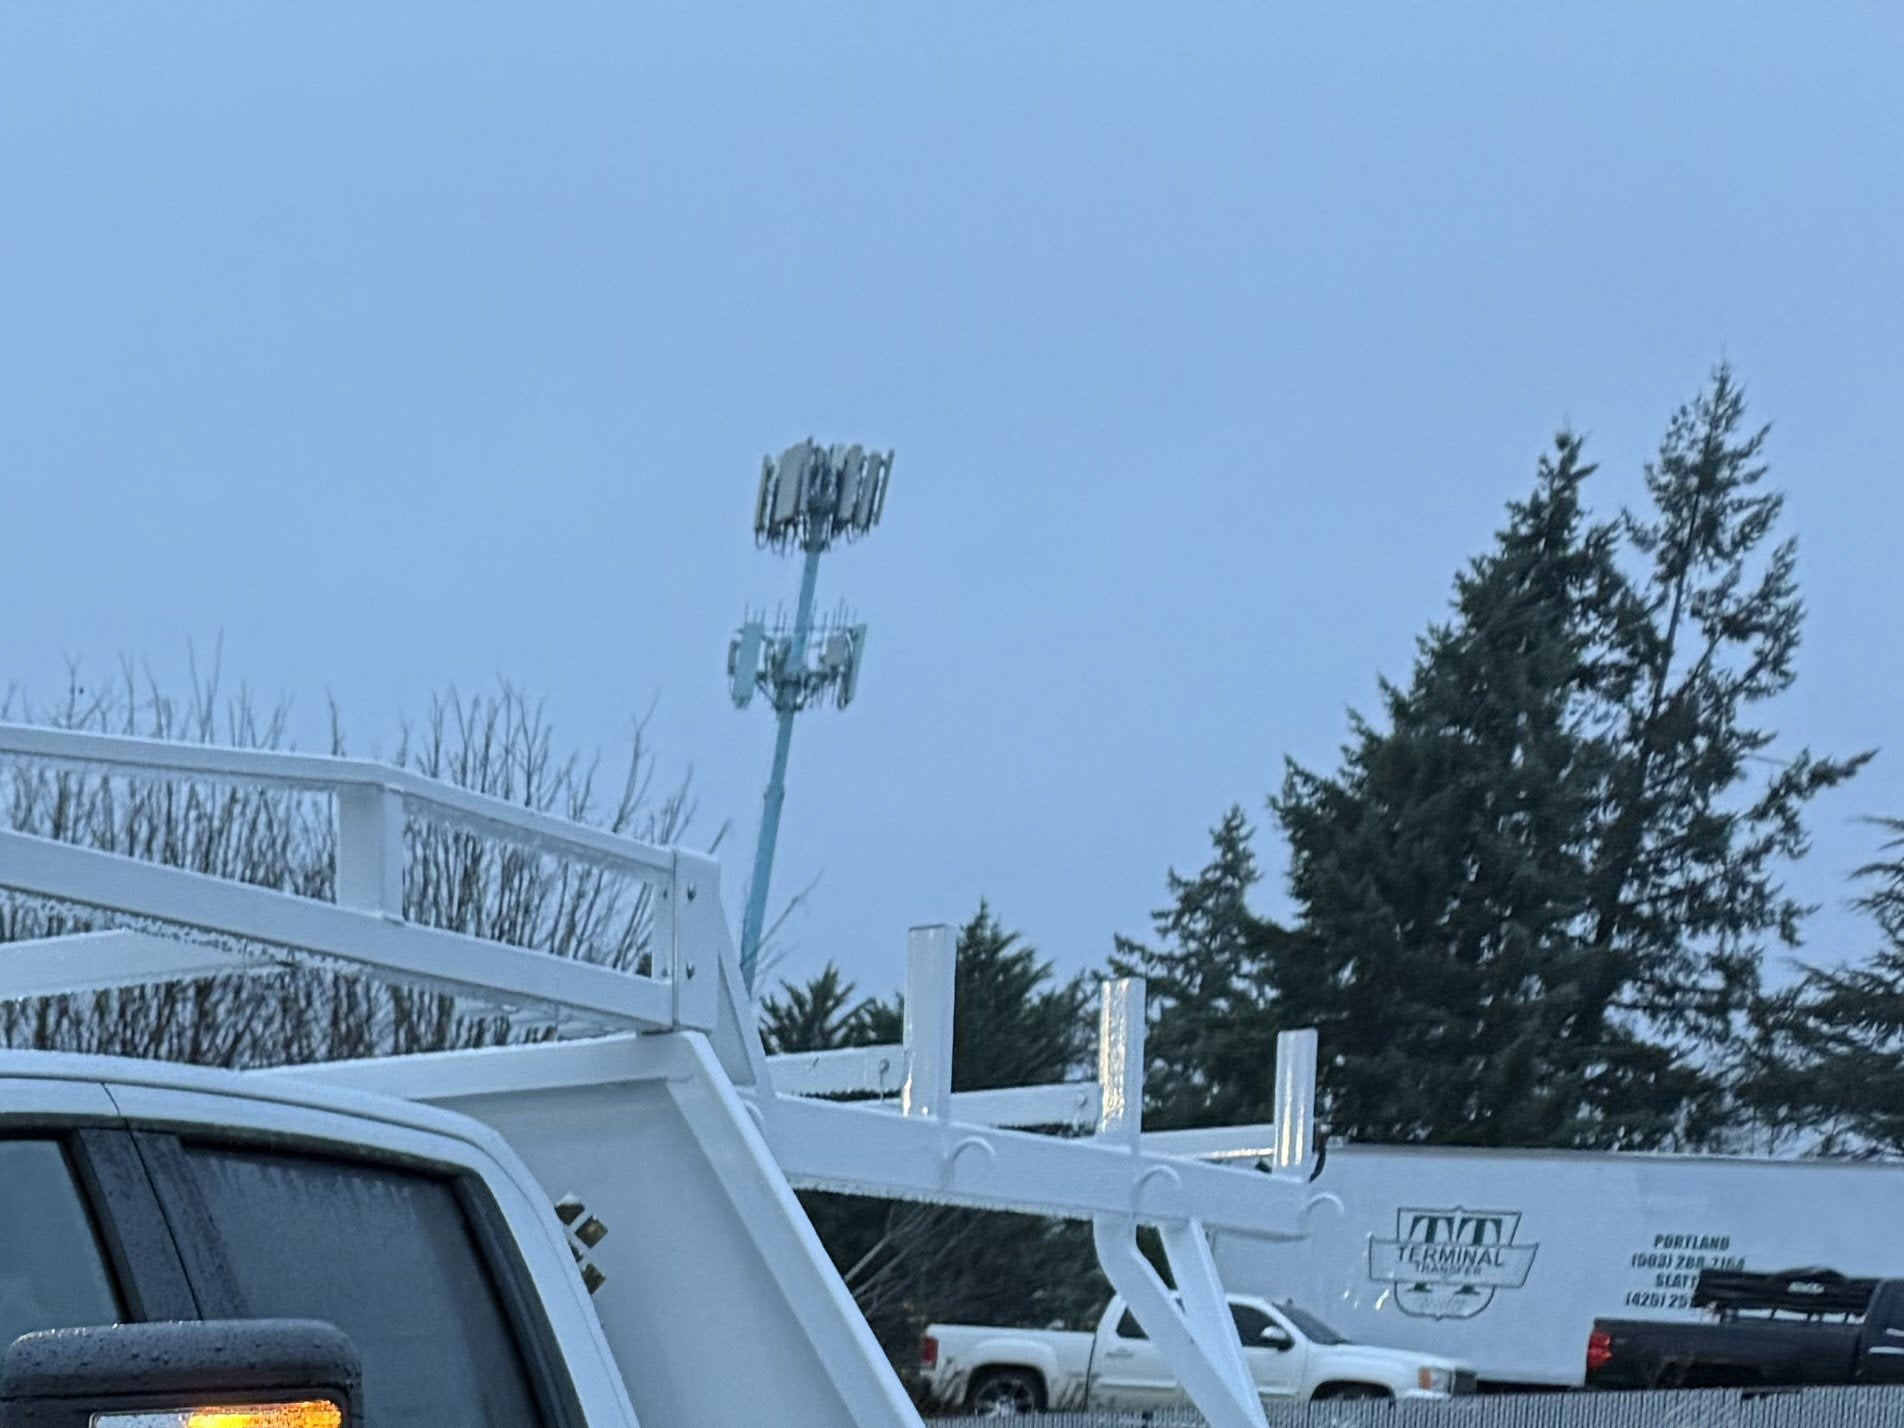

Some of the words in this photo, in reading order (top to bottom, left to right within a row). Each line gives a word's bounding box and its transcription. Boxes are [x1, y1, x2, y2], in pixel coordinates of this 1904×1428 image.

[1653, 1233, 1731, 1251] PORTLAND
[1398, 1246, 1505, 1268] TERMINAL
[1654, 1272, 1699, 1289] SEATT
